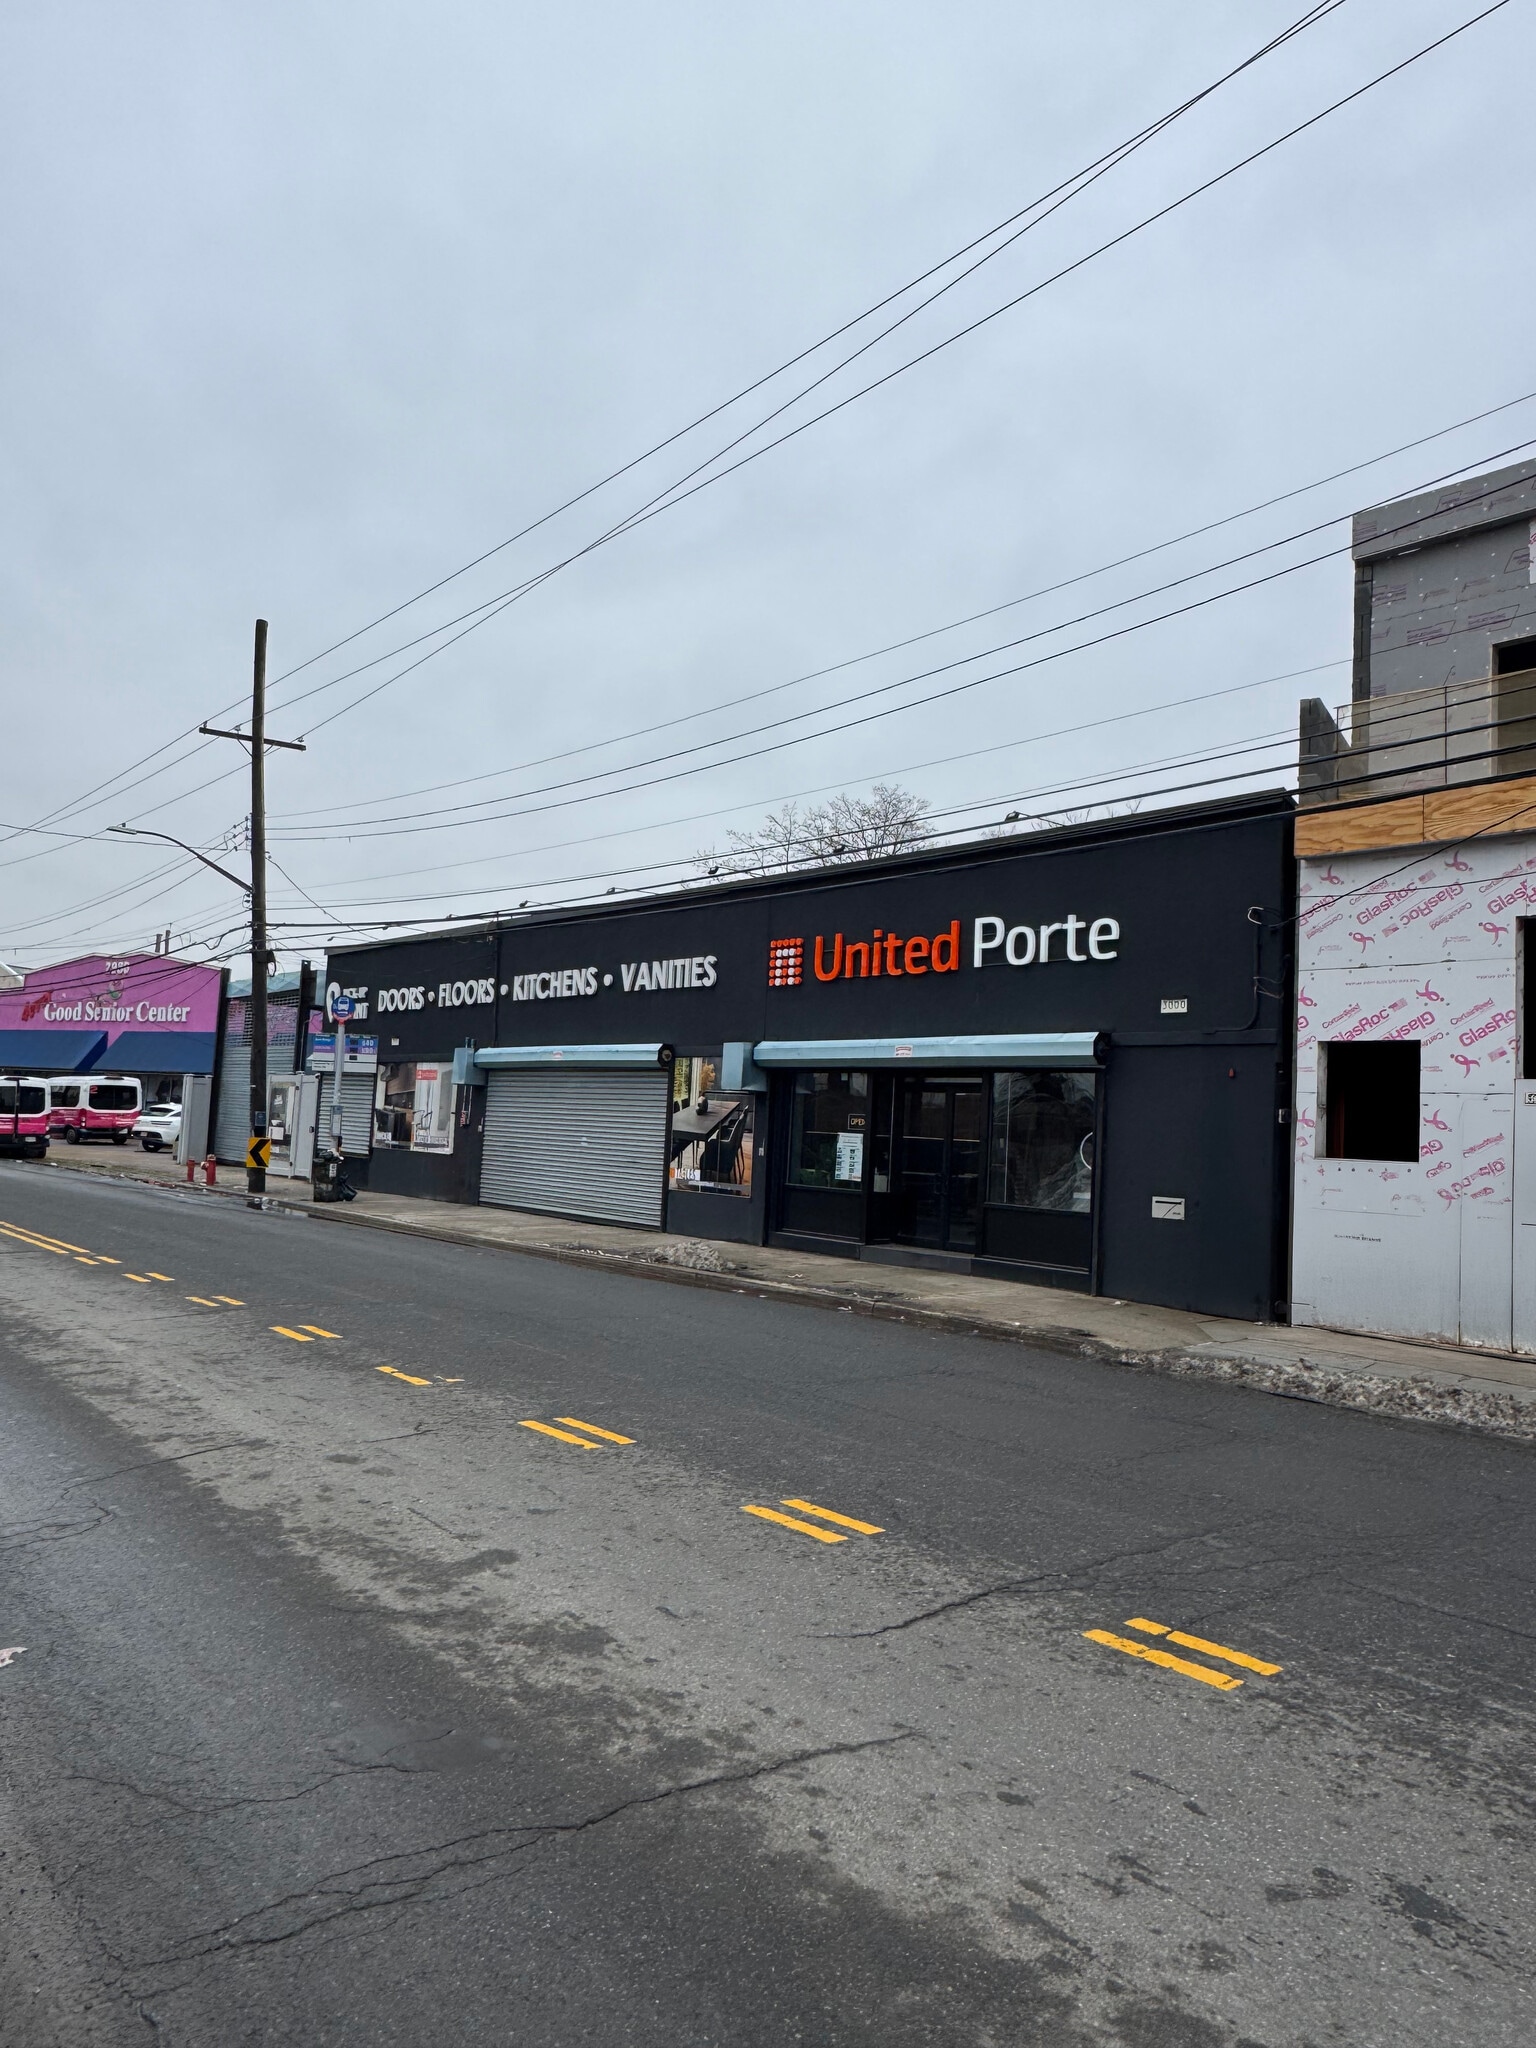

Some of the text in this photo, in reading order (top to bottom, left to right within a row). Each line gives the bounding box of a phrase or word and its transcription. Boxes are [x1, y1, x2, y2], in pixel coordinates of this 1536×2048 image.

[1356, 882, 1417, 925] GlasRoc
[1400, 881, 1464, 926] GlasRoc
[814, 914, 1120, 981] United Porte
[378, 986, 425, 1012] DOORS
[438, 978, 495, 1007] FLOORS
[513, 967, 598, 1001] KITCHENS
[621, 955, 718, 991] VANITIES
[44, 1002, 82, 1021] Good
[84, 1002, 134, 1022] Senior
[136, 1001, 190, 1022] Center
